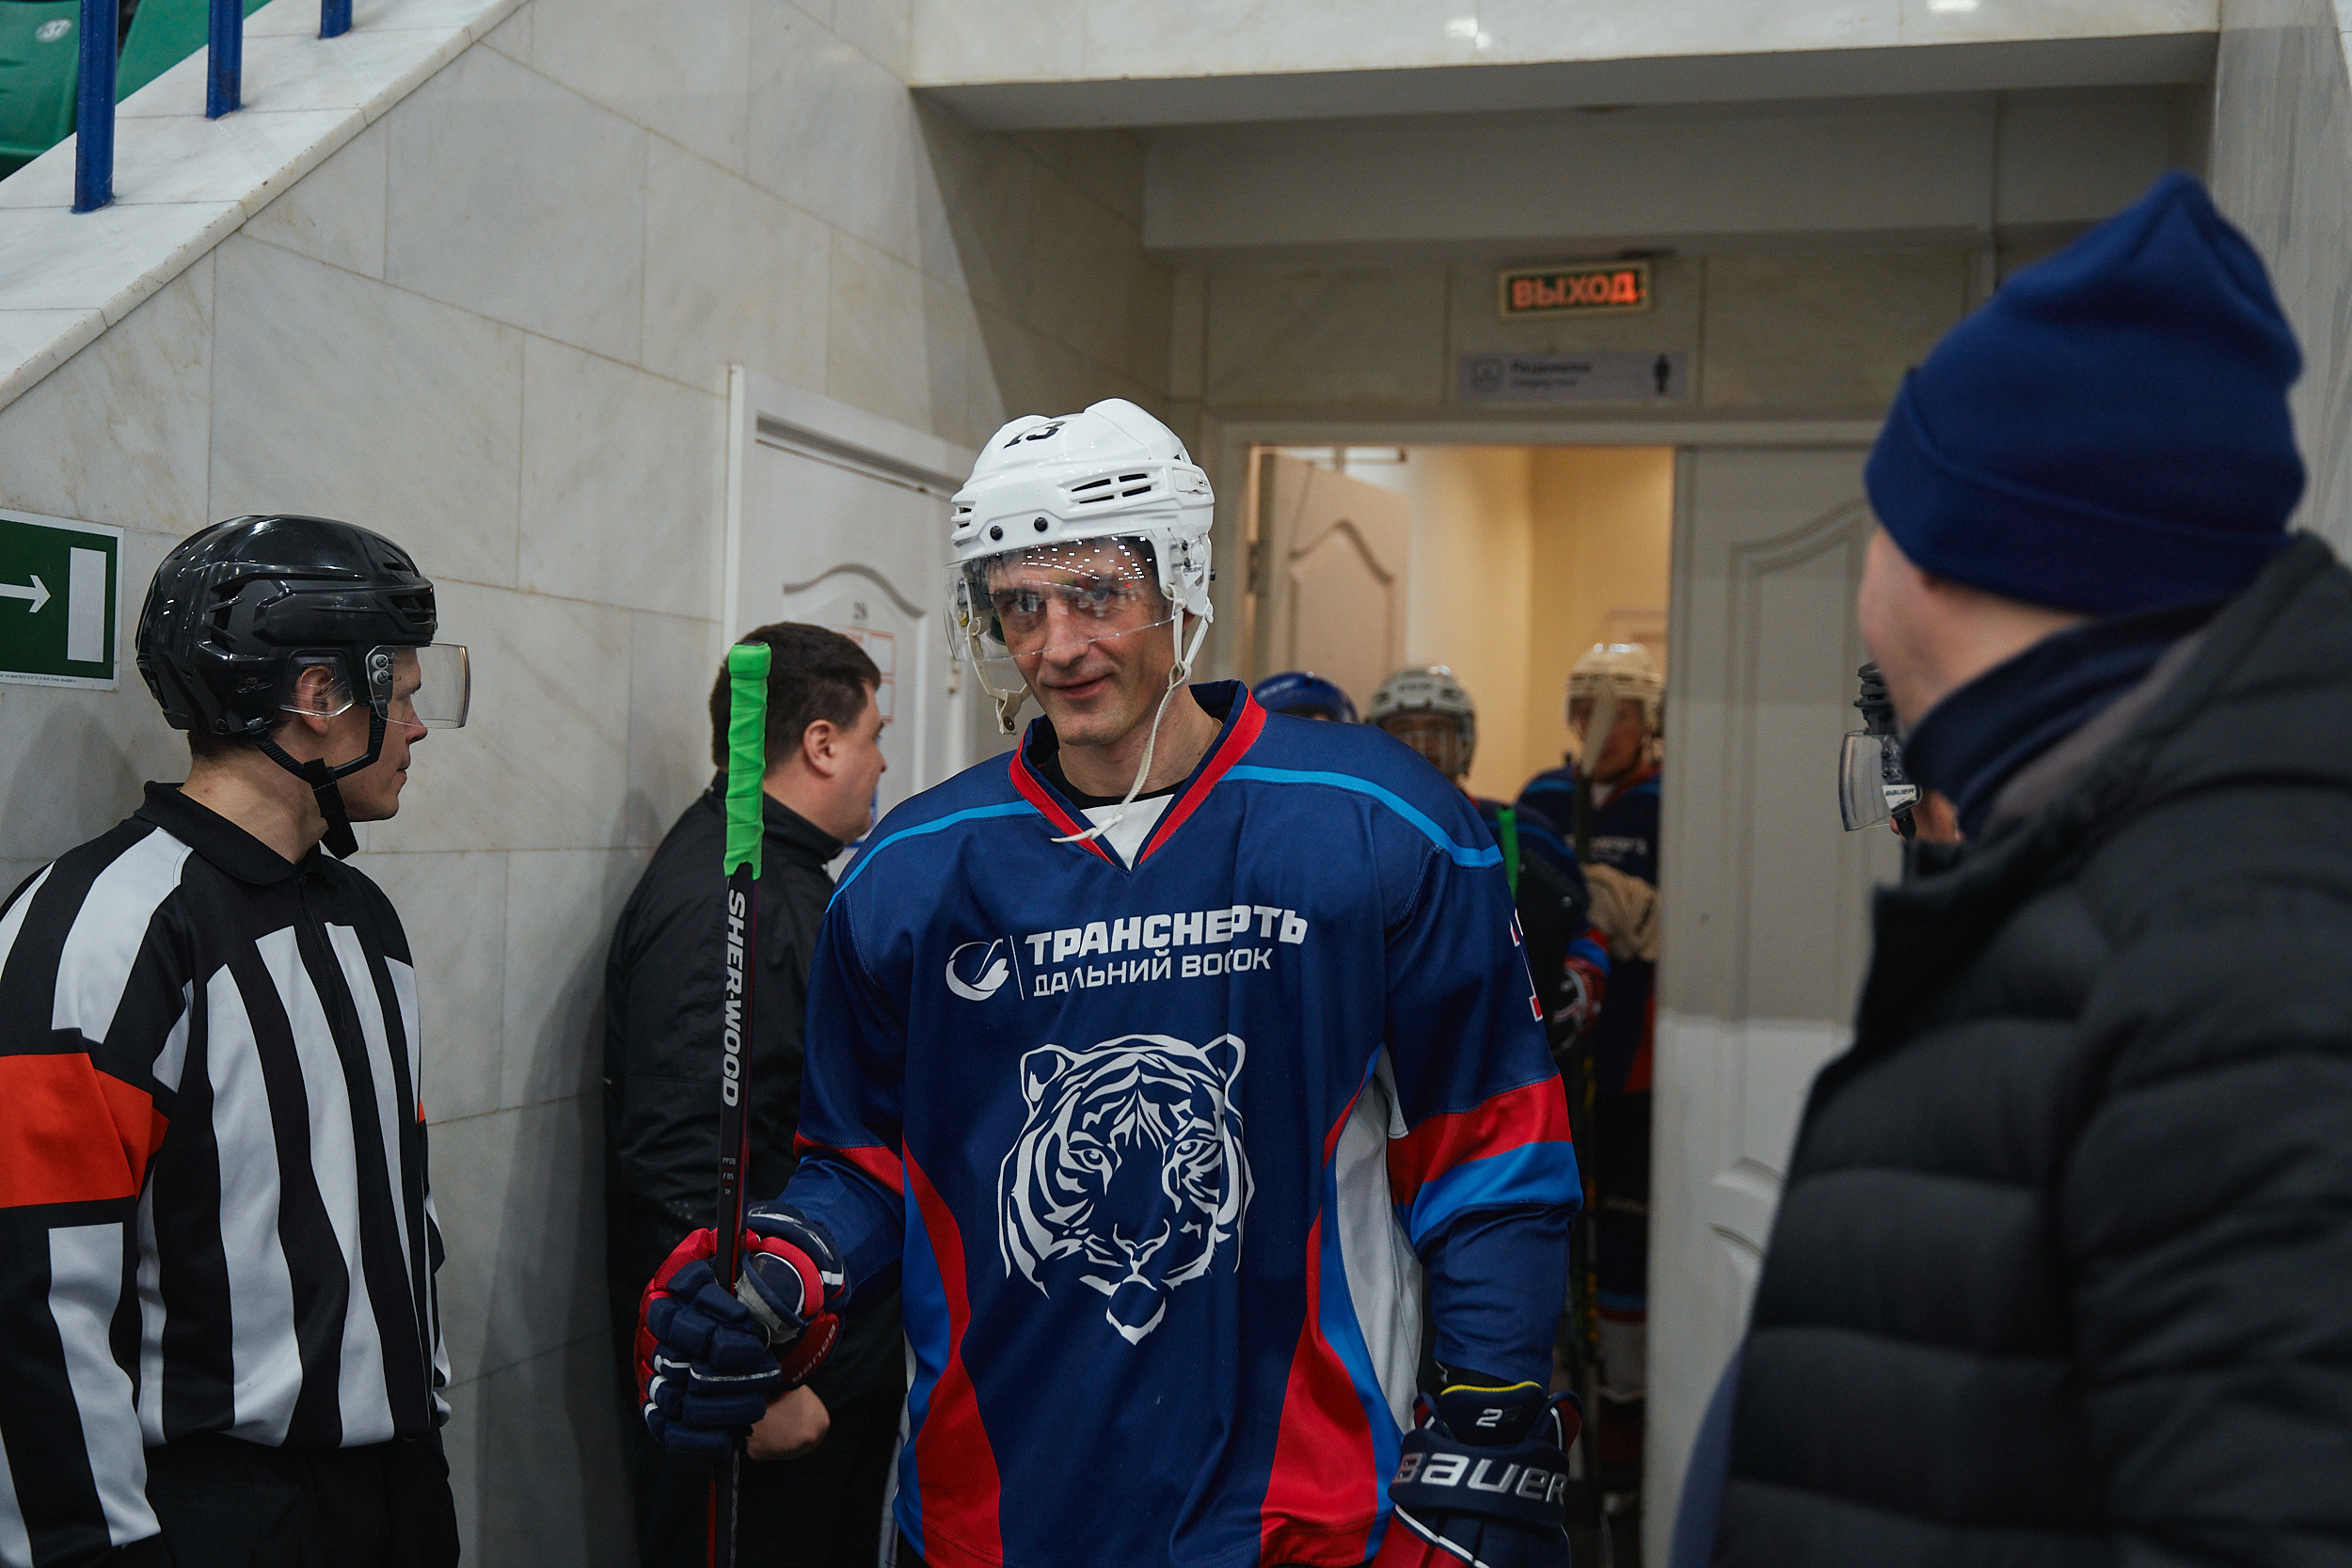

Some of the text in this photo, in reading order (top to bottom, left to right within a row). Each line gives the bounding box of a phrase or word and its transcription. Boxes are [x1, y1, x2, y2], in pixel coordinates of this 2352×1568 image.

[1512, 271, 1637, 309] ВЫХОД
[1033, 948, 1172, 997] ДАЛЬНИЙ
[723, 889, 746, 1107] SHER-WOOD
